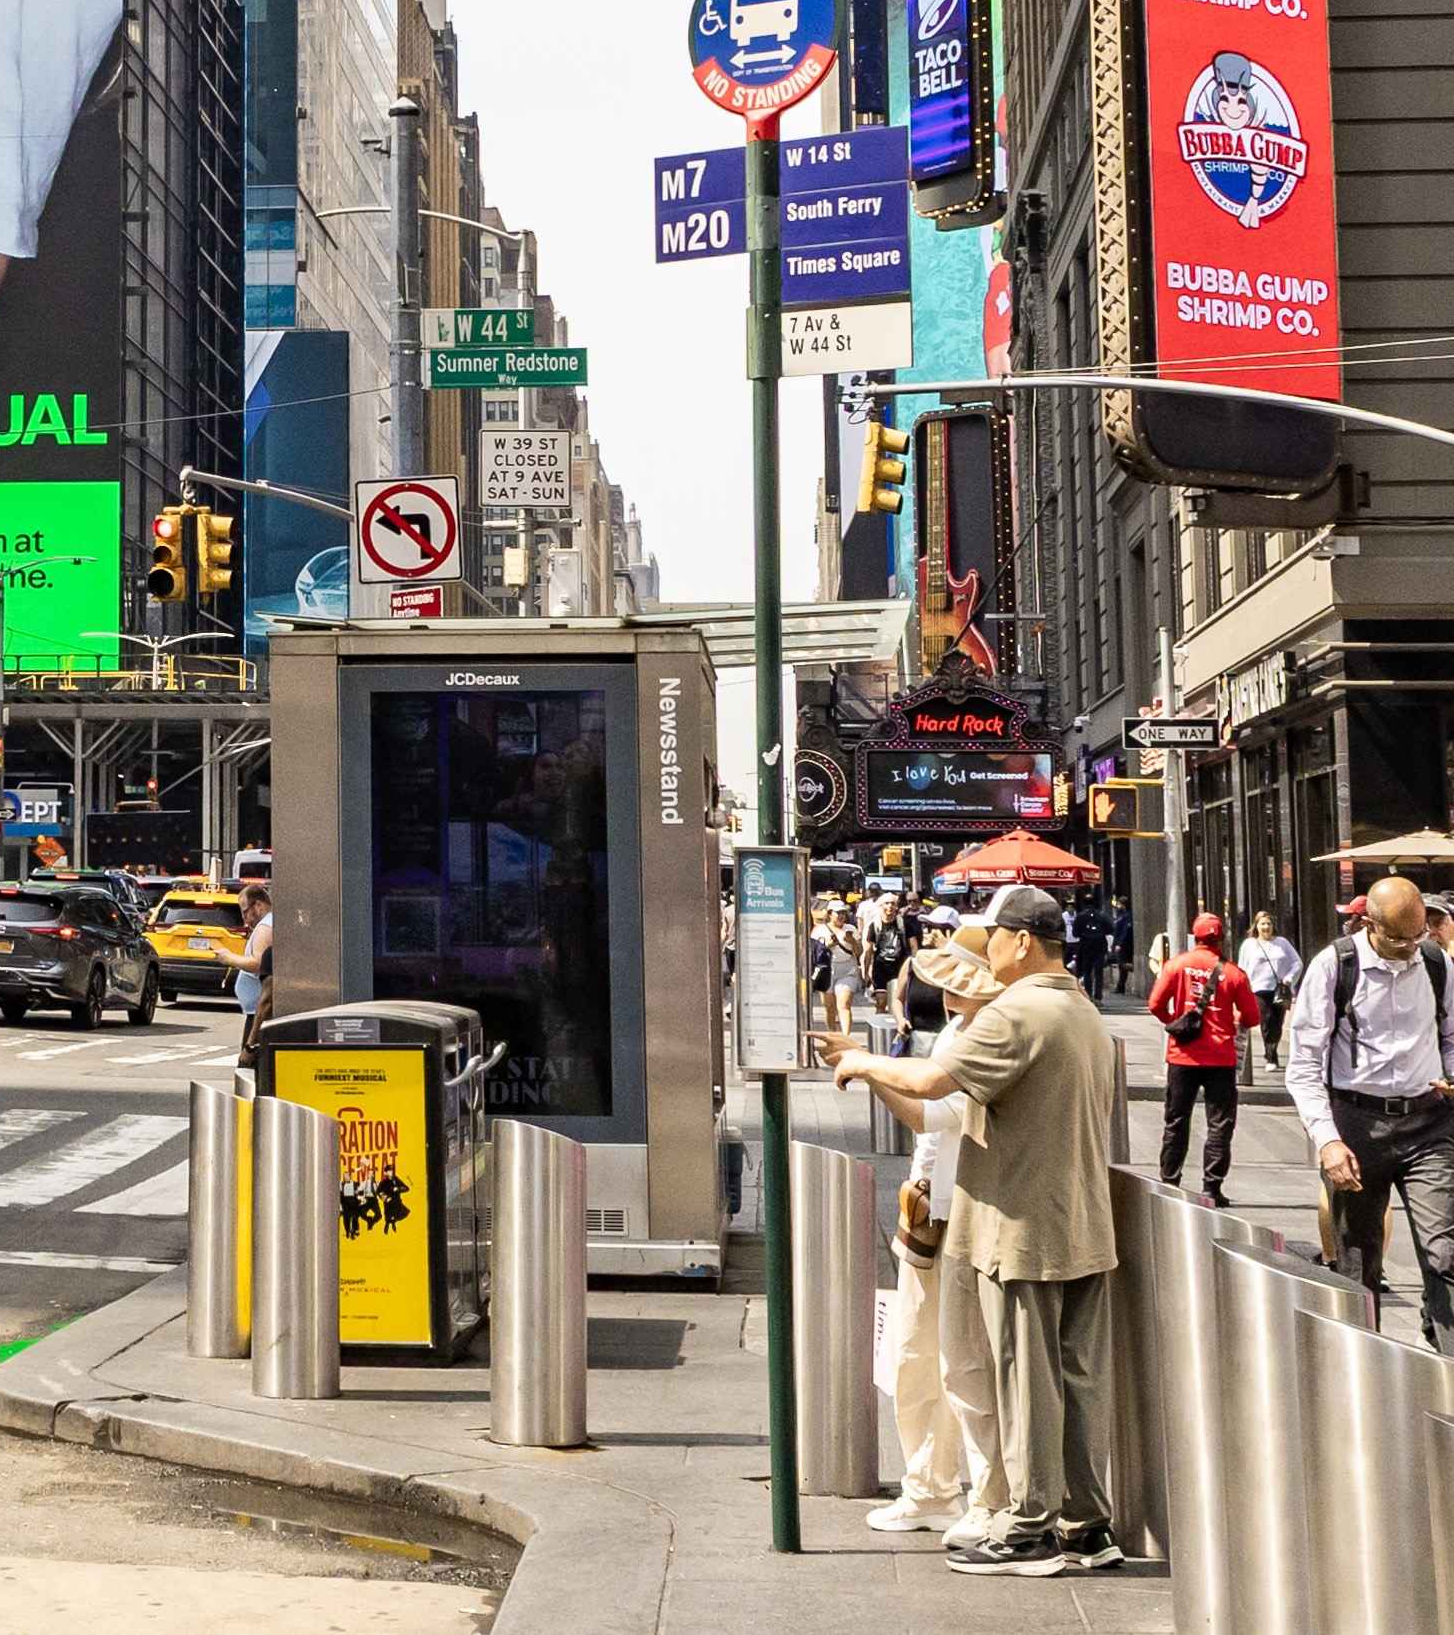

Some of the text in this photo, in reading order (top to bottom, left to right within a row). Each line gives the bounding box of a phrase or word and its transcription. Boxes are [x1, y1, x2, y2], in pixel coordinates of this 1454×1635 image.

[914, 39, 964, 74] TACO
[702, 58, 823, 109] NO STANDING
[917, 64, 964, 100] BELL
[786, 142, 851, 168] W 14 St
[1183, 128, 1304, 171] BUBBA GUMP
[660, 159, 706, 202] M7
[1204, 161, 1285, 183] SHRIMP CO
[786, 193, 884, 223] South Ferry
[660, 211, 731, 254] M20
[787, 246, 902, 277] Times Square
[1166, 261, 1329, 306] BUBBA GUMP
[456, 309, 530, 344] W 44 St
[789, 314, 841, 333] 7 Av &
[1177, 293, 1321, 338] SHRIMP CO.
[788, 334, 853, 355] W 44 St
[435, 350, 580, 374] Sumner Redstone
[497, 373, 519, 387] Way
[493, 437, 560, 452] W 39 ST
[492, 453, 560, 469] CLOSED
[487, 469, 565, 485] AT 9 AVE
[13, 529, 45, 554] at
[392, 592, 435, 608] NO STANDING
[445, 672, 520, 687] JCDecaux
[915, 713, 1005, 737] Hard Rock
[1137, 728, 1207, 740] ONE WAY
[658, 676, 684, 826] Newsstand
[892, 769, 903, 783] I
[969, 771, 986, 781] Get
[986, 771, 1030, 781] Screened
[745, 898, 784, 909] Arrivals
[764, 886, 785, 897] Bus
[313, 1074, 387, 1082] FUNNIEST MUSICAL
[338, 1120, 398, 1153] RATION
